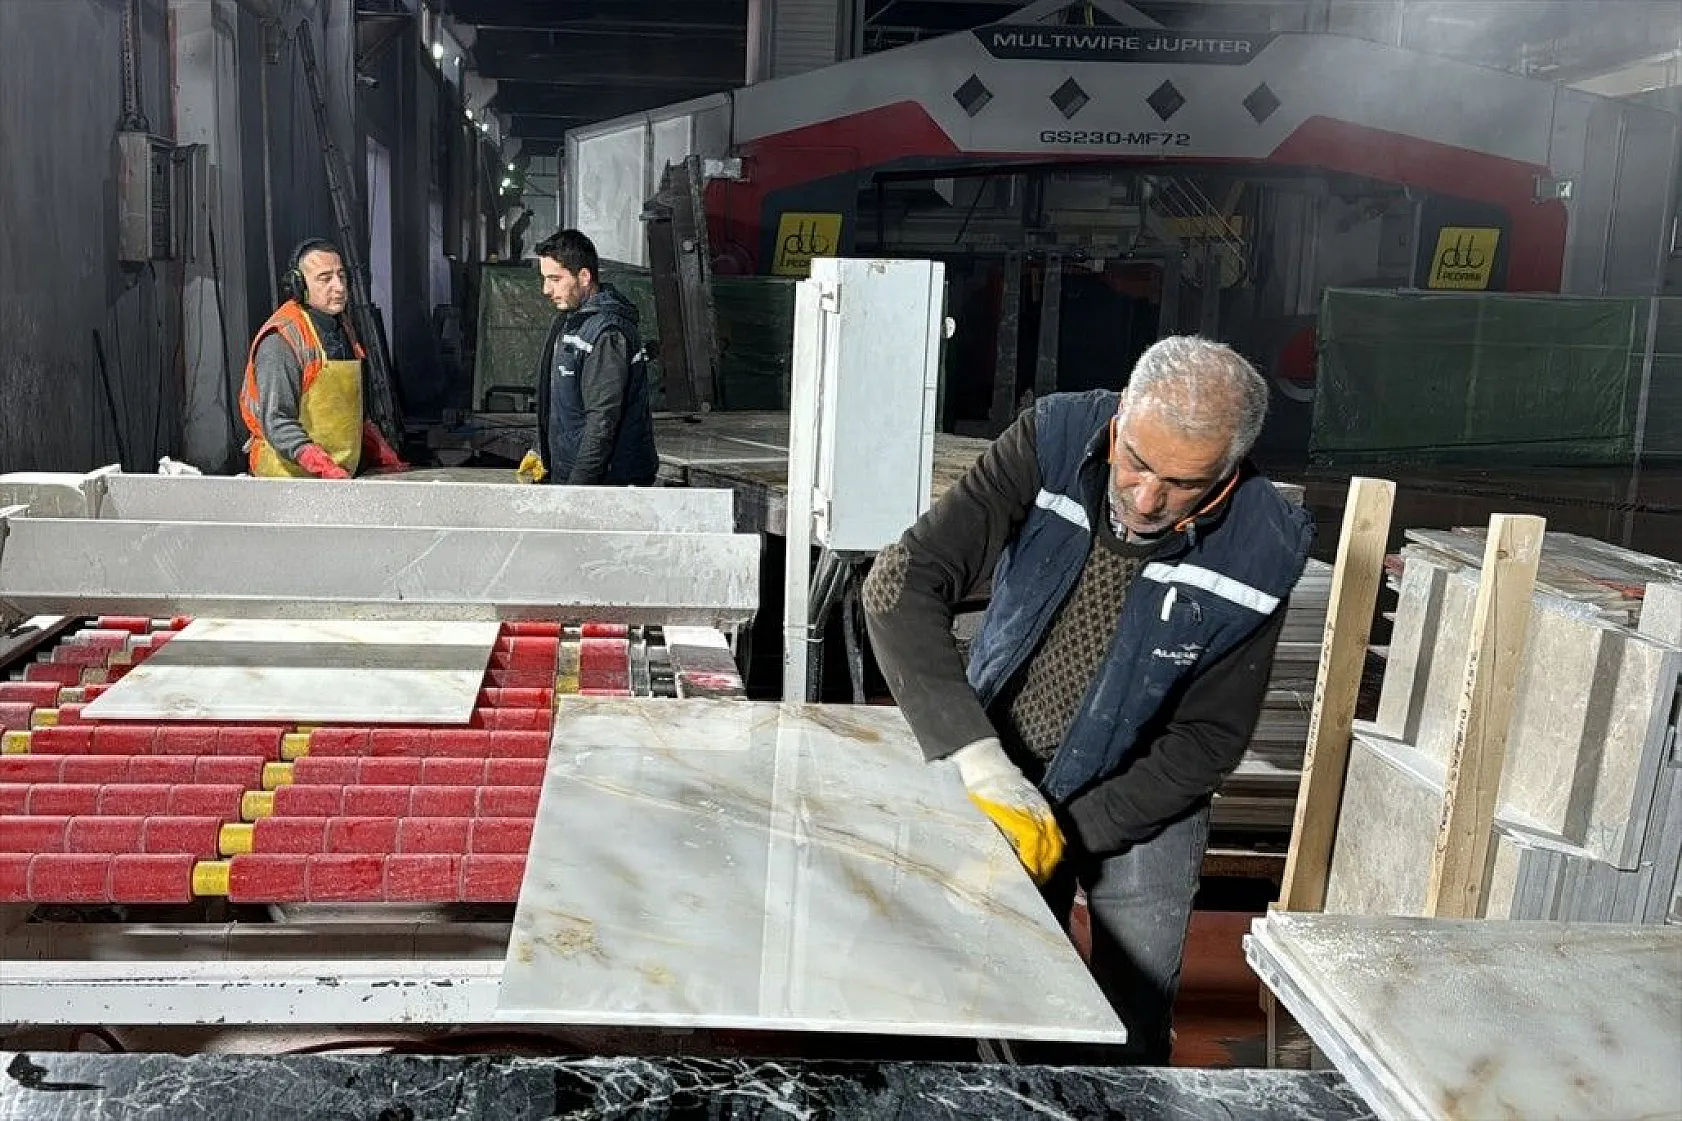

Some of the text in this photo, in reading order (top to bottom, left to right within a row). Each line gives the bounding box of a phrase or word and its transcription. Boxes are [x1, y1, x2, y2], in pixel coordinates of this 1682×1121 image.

[993, 32, 1251, 53] MULTIWIRE JUPITER
[1039, 130, 1191, 146] GS230-MF72
